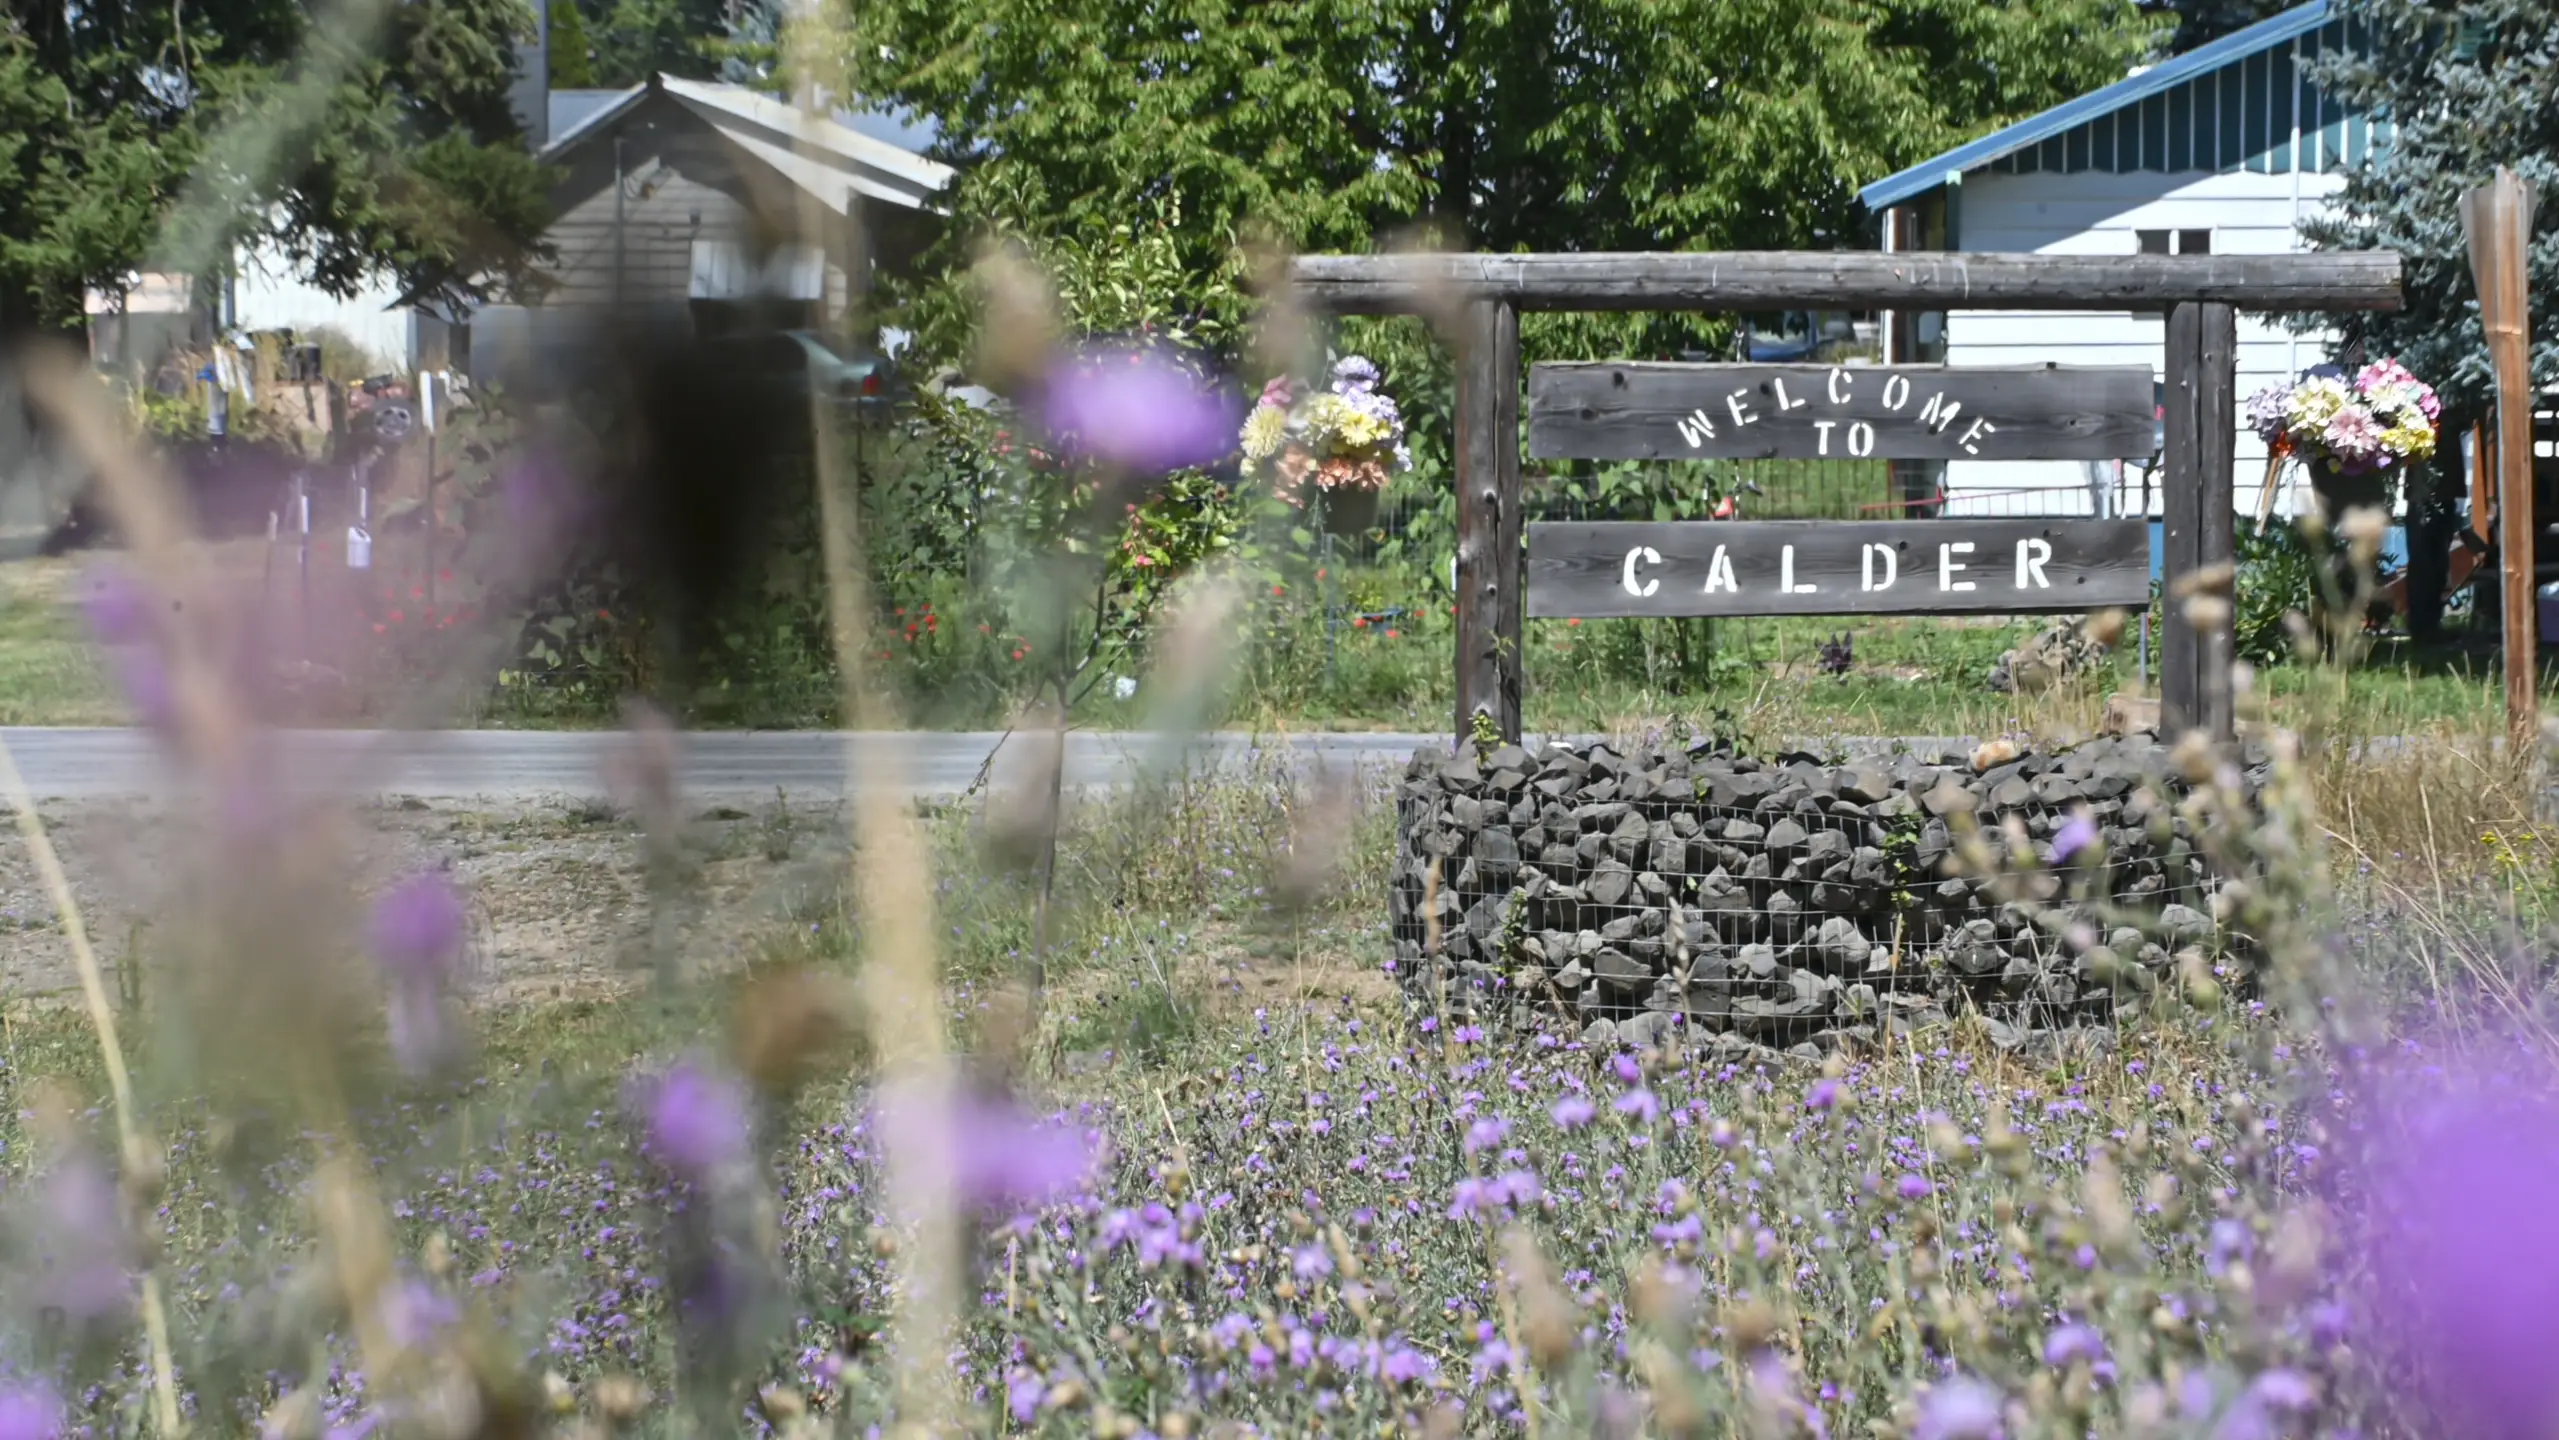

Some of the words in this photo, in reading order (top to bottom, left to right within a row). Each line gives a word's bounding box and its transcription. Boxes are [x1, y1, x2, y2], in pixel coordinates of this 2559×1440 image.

[1677, 368, 1996, 456] WELCOME
[1813, 421, 1875, 457] TO
[1622, 538, 2053, 598] CALDER
